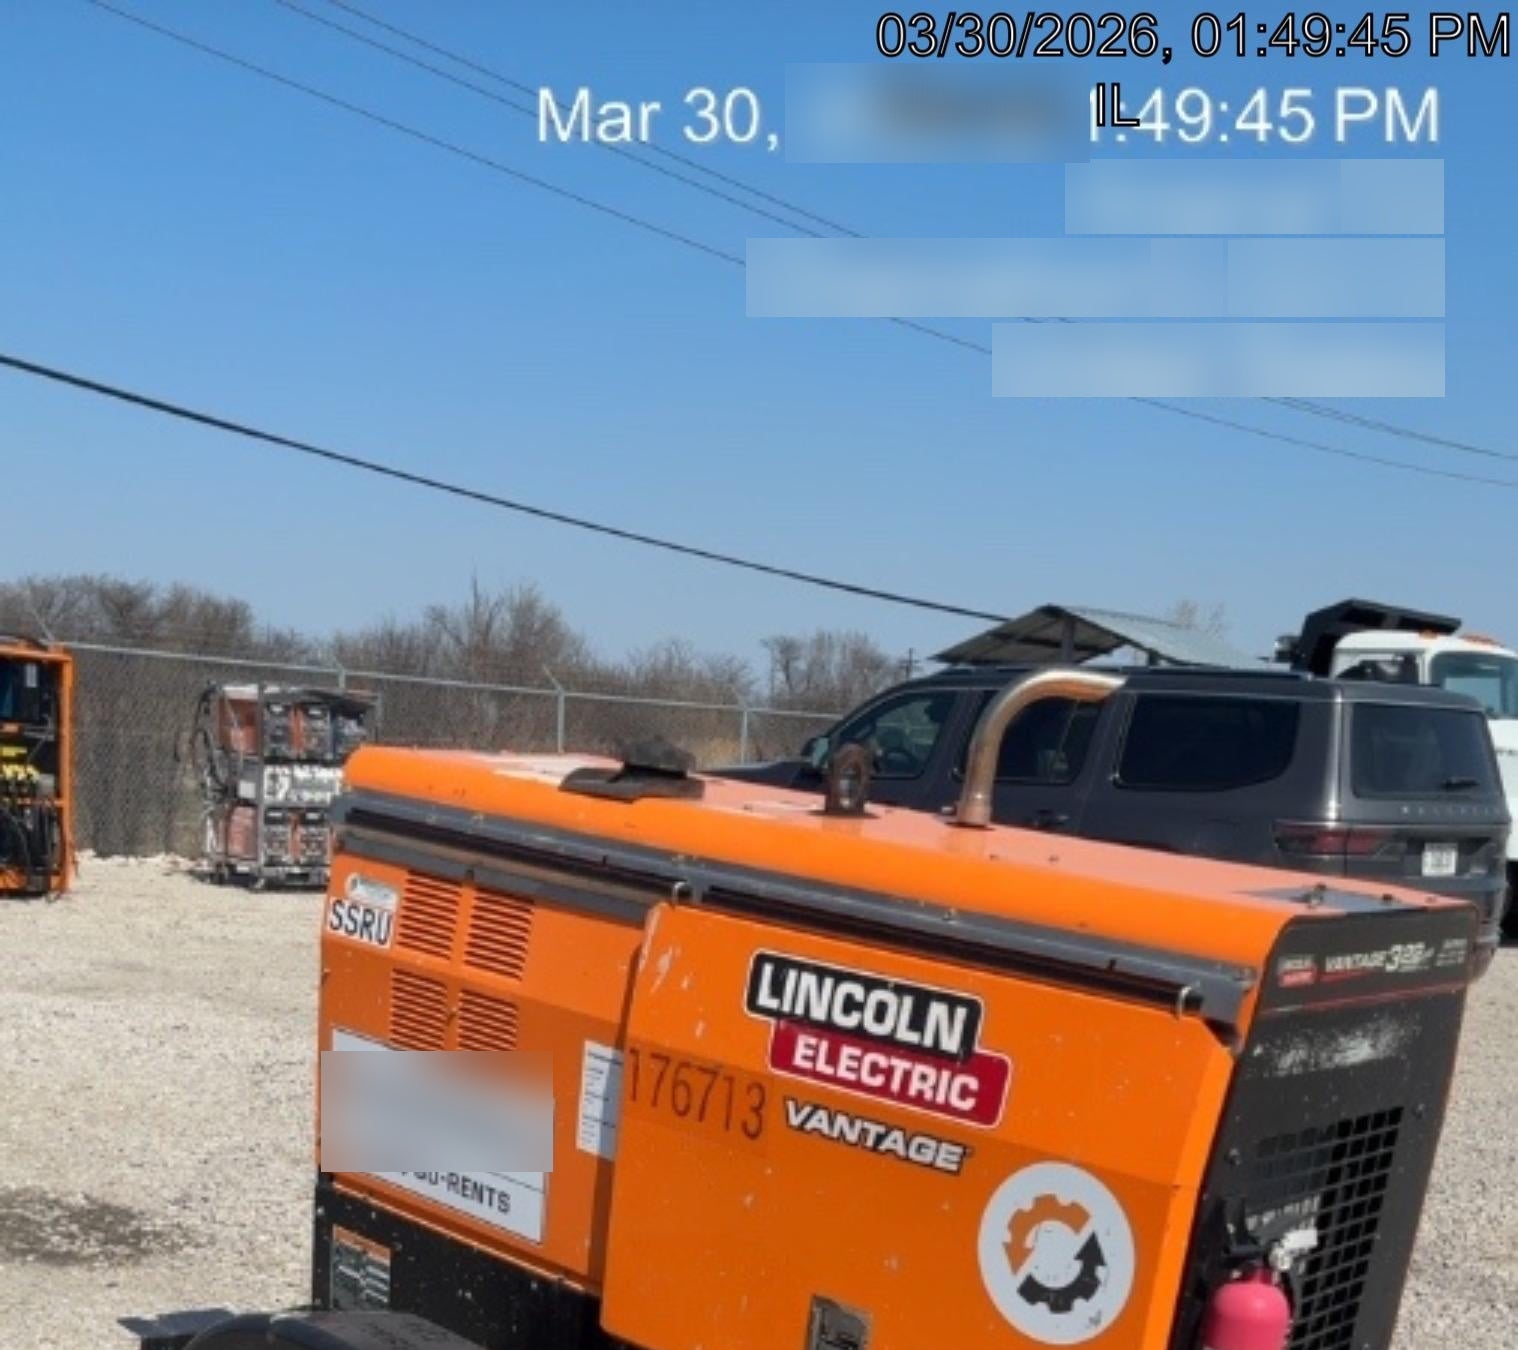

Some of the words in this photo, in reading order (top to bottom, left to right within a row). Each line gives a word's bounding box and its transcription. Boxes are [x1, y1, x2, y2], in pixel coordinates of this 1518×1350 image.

[329, 899, 393, 945] SSRU
[756, 962, 967, 1053] LINCOLN
[628, 1046, 767, 1141] 176713
[793, 1037, 979, 1111] ELECTRIC
[785, 1099, 967, 1175] VANTAGE
